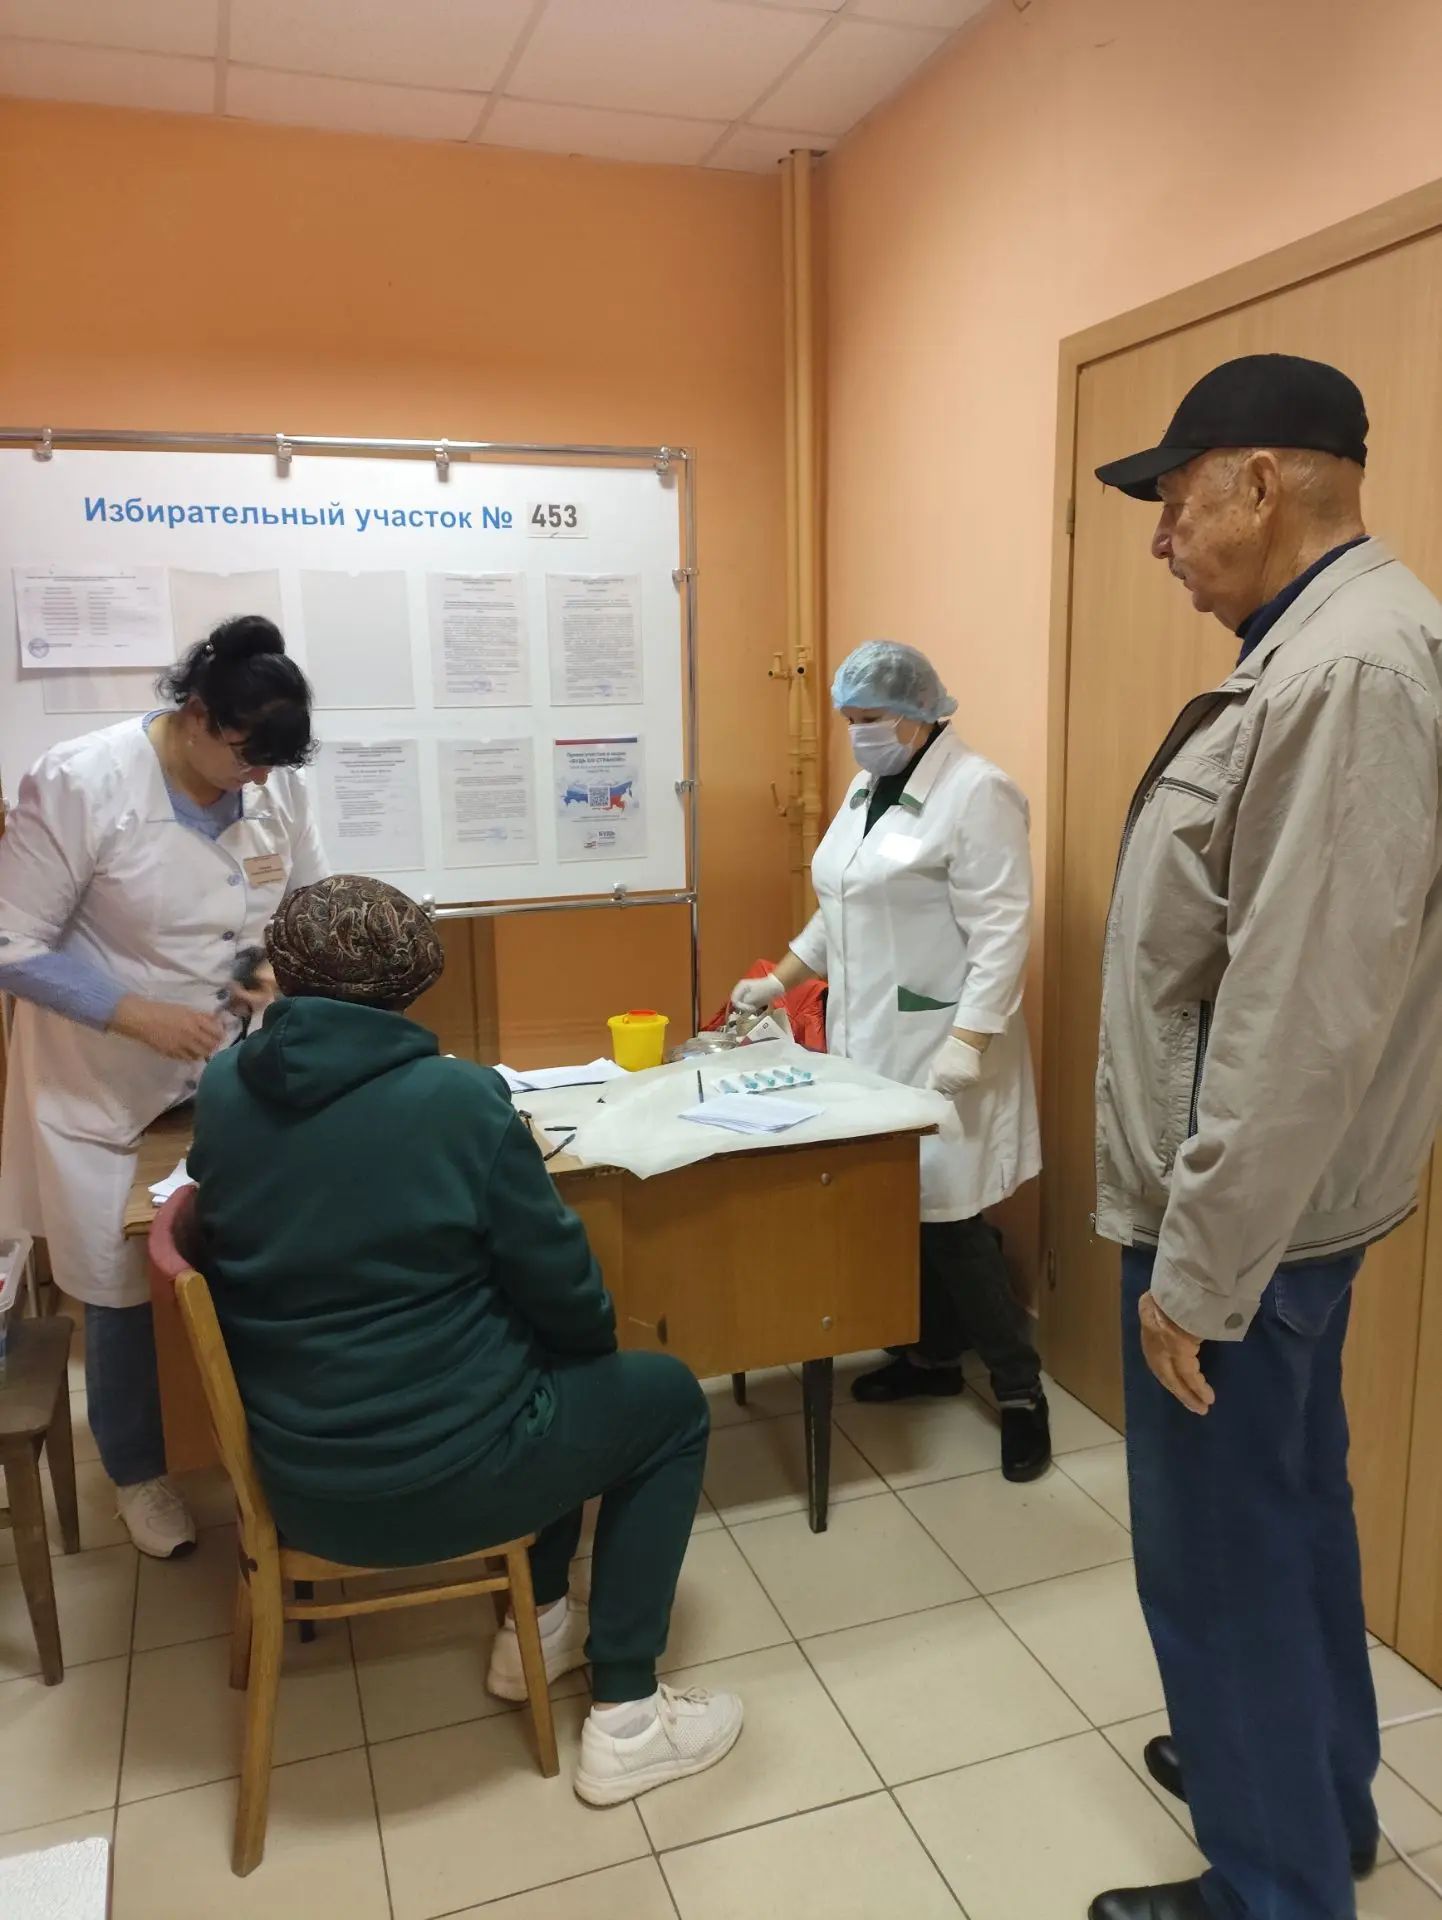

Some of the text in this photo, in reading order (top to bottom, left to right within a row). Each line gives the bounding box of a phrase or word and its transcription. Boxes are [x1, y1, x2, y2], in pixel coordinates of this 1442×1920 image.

[84, 497, 578, 533] Избирательный участок № 453
